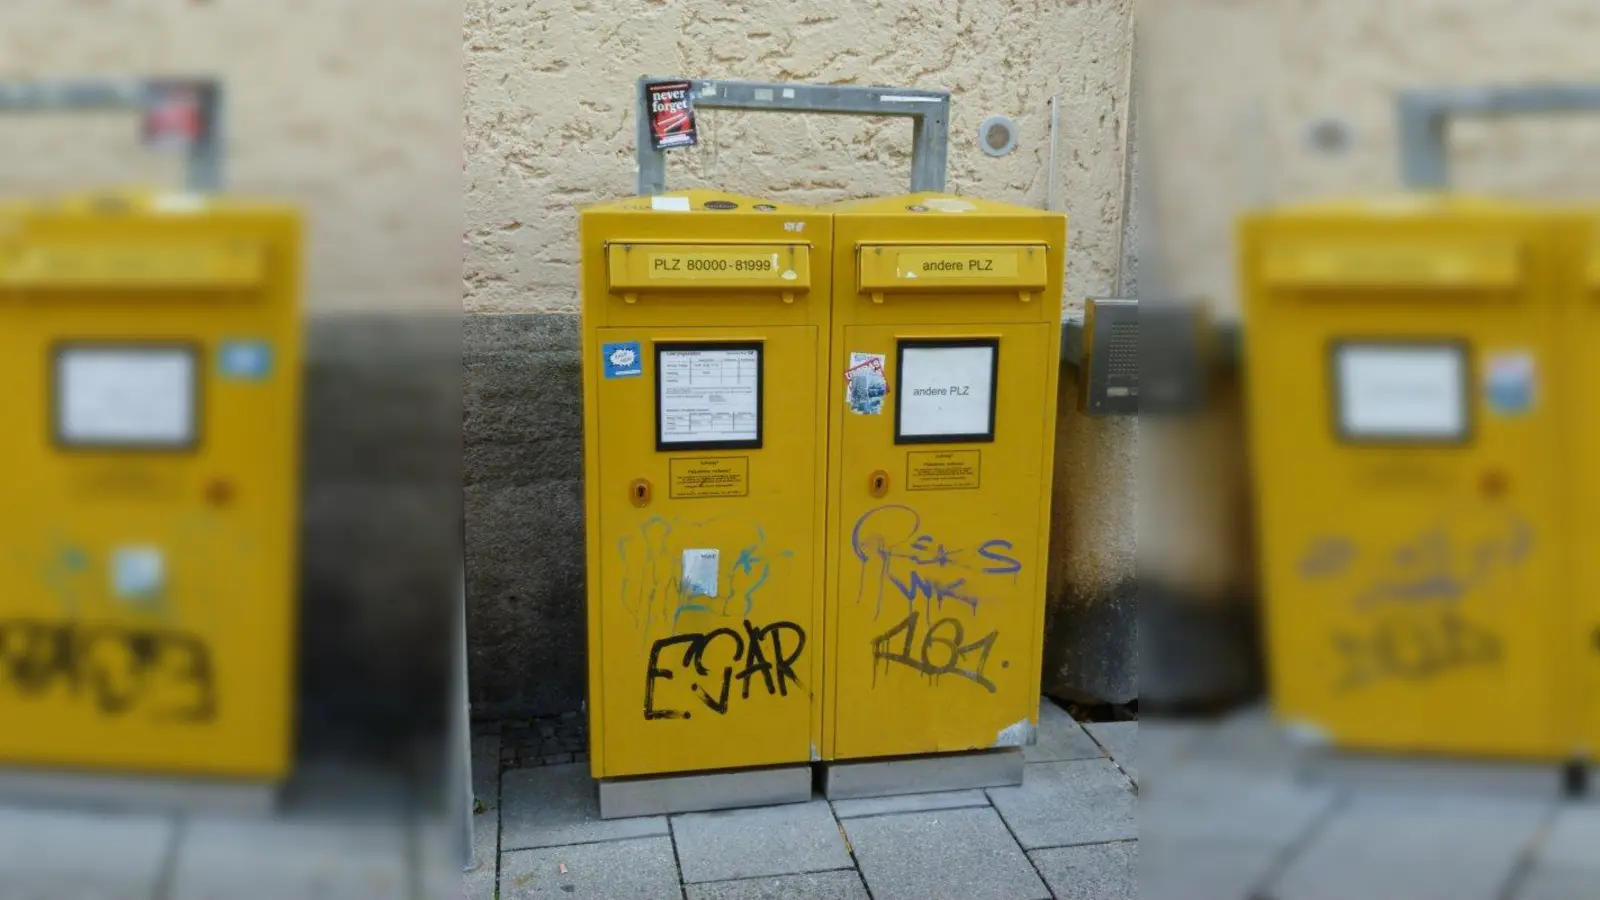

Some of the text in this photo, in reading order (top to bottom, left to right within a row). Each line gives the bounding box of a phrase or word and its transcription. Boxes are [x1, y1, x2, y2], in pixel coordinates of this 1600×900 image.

[653, 90, 685, 101] never
[652, 100, 688, 113] forget
[654, 259, 771, 271] PLZ 80000-81999
[922, 260, 993, 271] andere PLZ
[913, 386, 969, 396] andere PLZ
